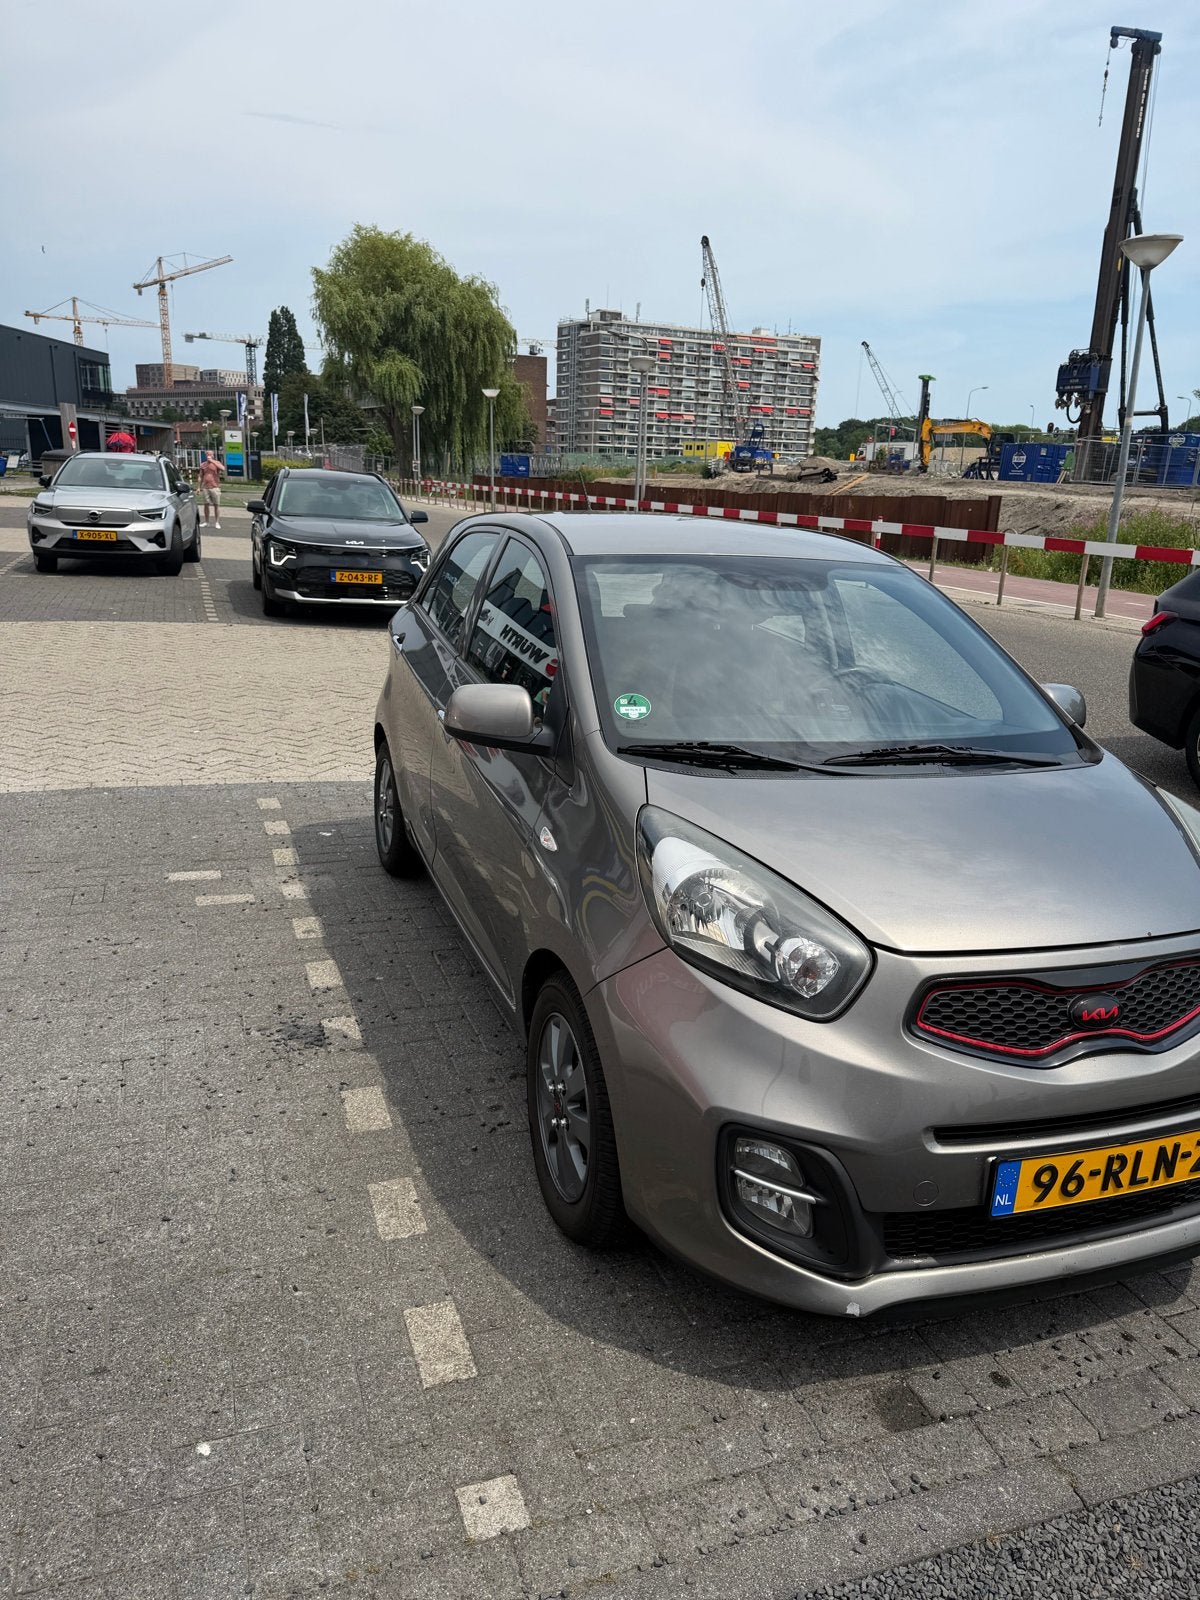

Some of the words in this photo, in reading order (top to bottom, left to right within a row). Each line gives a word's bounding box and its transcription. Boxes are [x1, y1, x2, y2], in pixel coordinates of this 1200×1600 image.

[79, 531, 114, 540] X-905-XL
[339, 572, 379, 582] Z-043-RF
[627, 695, 637, 706] 4
[995, 1193, 1012, 1207] NL
